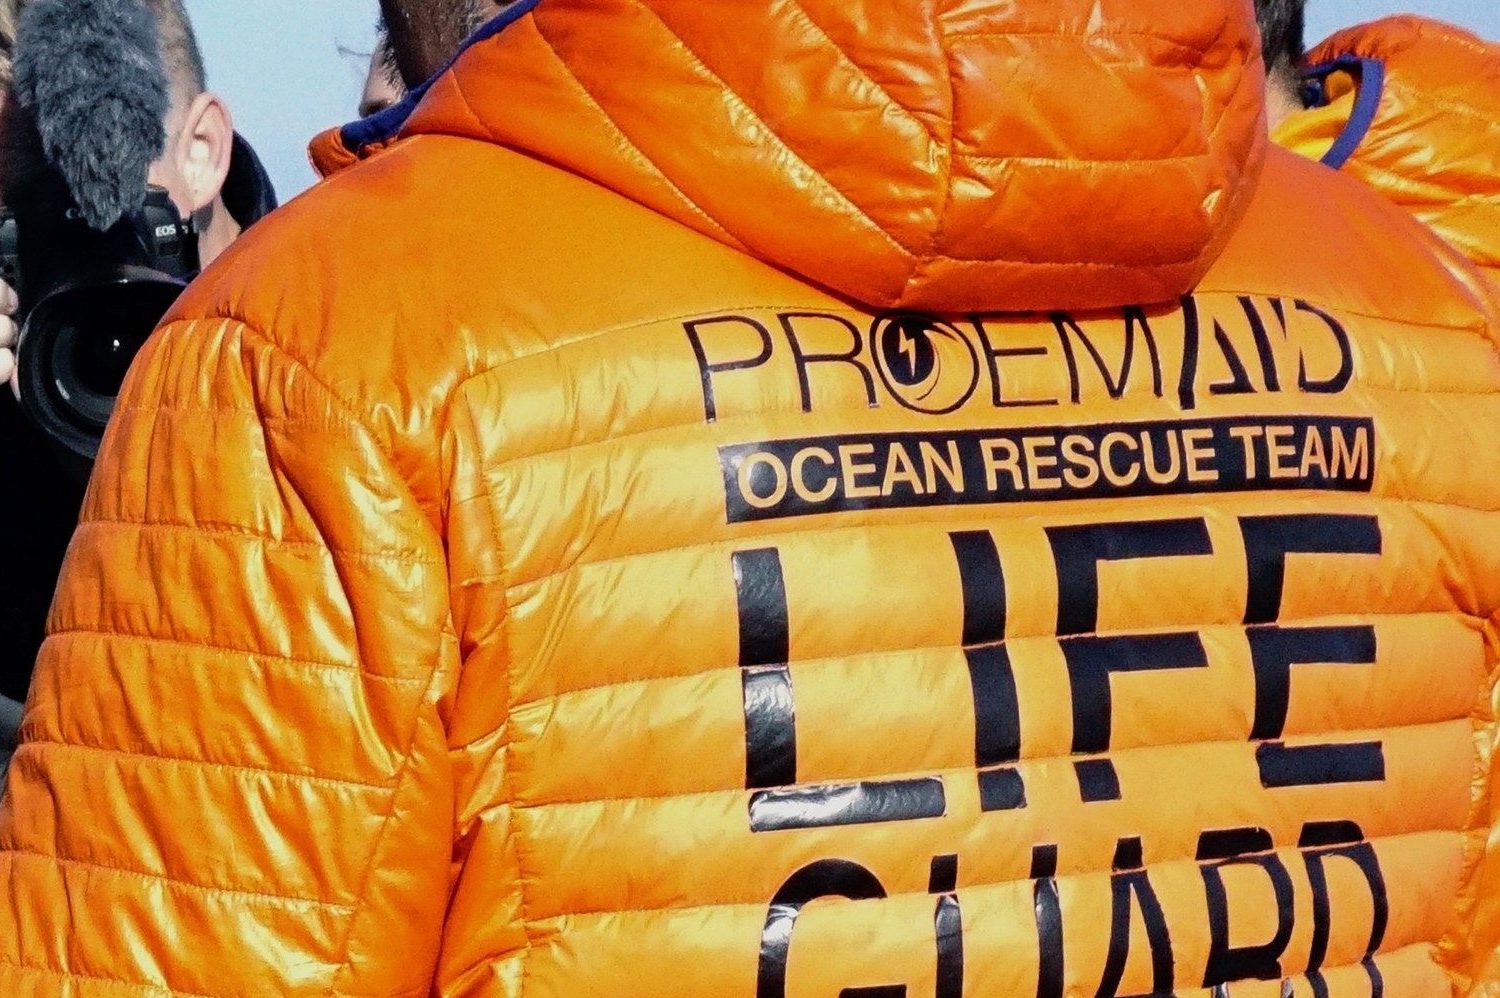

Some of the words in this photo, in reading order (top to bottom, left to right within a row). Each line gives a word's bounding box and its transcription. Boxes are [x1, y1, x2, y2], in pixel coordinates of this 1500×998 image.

[155, 223, 176, 237] EOS
[736, 440, 966, 509] OCEAN
[983, 426, 1219, 492] RESCUE
[1234, 425, 1370, 481] TEAM
[732, 514, 1385, 832] LIFE
